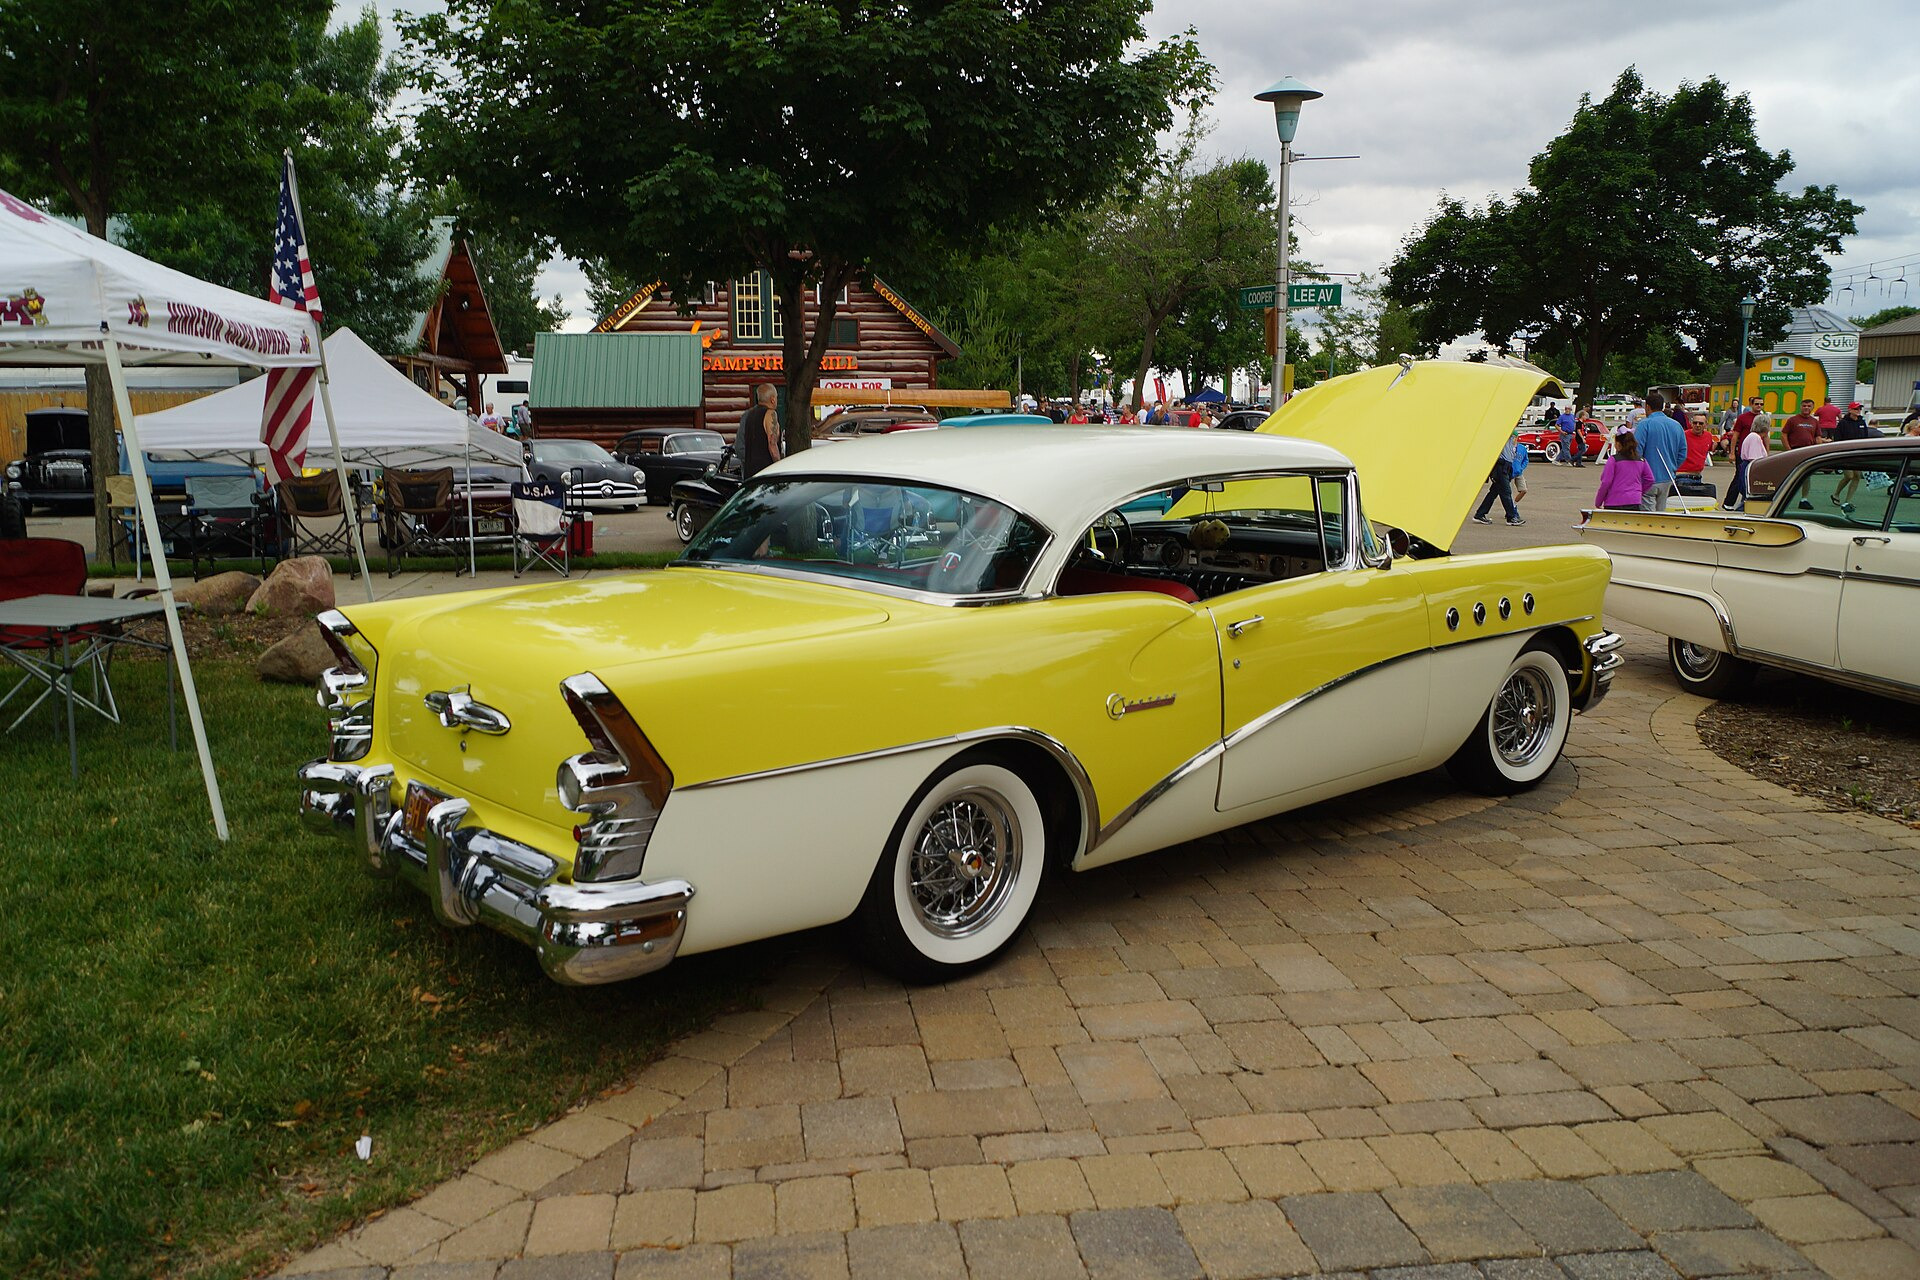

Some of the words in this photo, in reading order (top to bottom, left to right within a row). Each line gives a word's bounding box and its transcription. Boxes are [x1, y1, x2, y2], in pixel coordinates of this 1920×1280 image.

[1248, 291, 1273, 304] COOPER
[1294, 288, 1315, 302] LEE
[1318, 288, 1334, 302] AV
[598, 315, 617, 333] ICE
[616, 293, 643, 318] COLD
[880, 287, 906, 312] COLD
[906, 309, 932, 334] BEER
[167, 301, 224, 342] MINNESOTA
[255, 325, 291, 355] GOPHERS
[703, 356, 784, 371] CAMPFIR
[818, 355, 858, 370] RILL
[522, 485, 554, 498] U.S.A.
